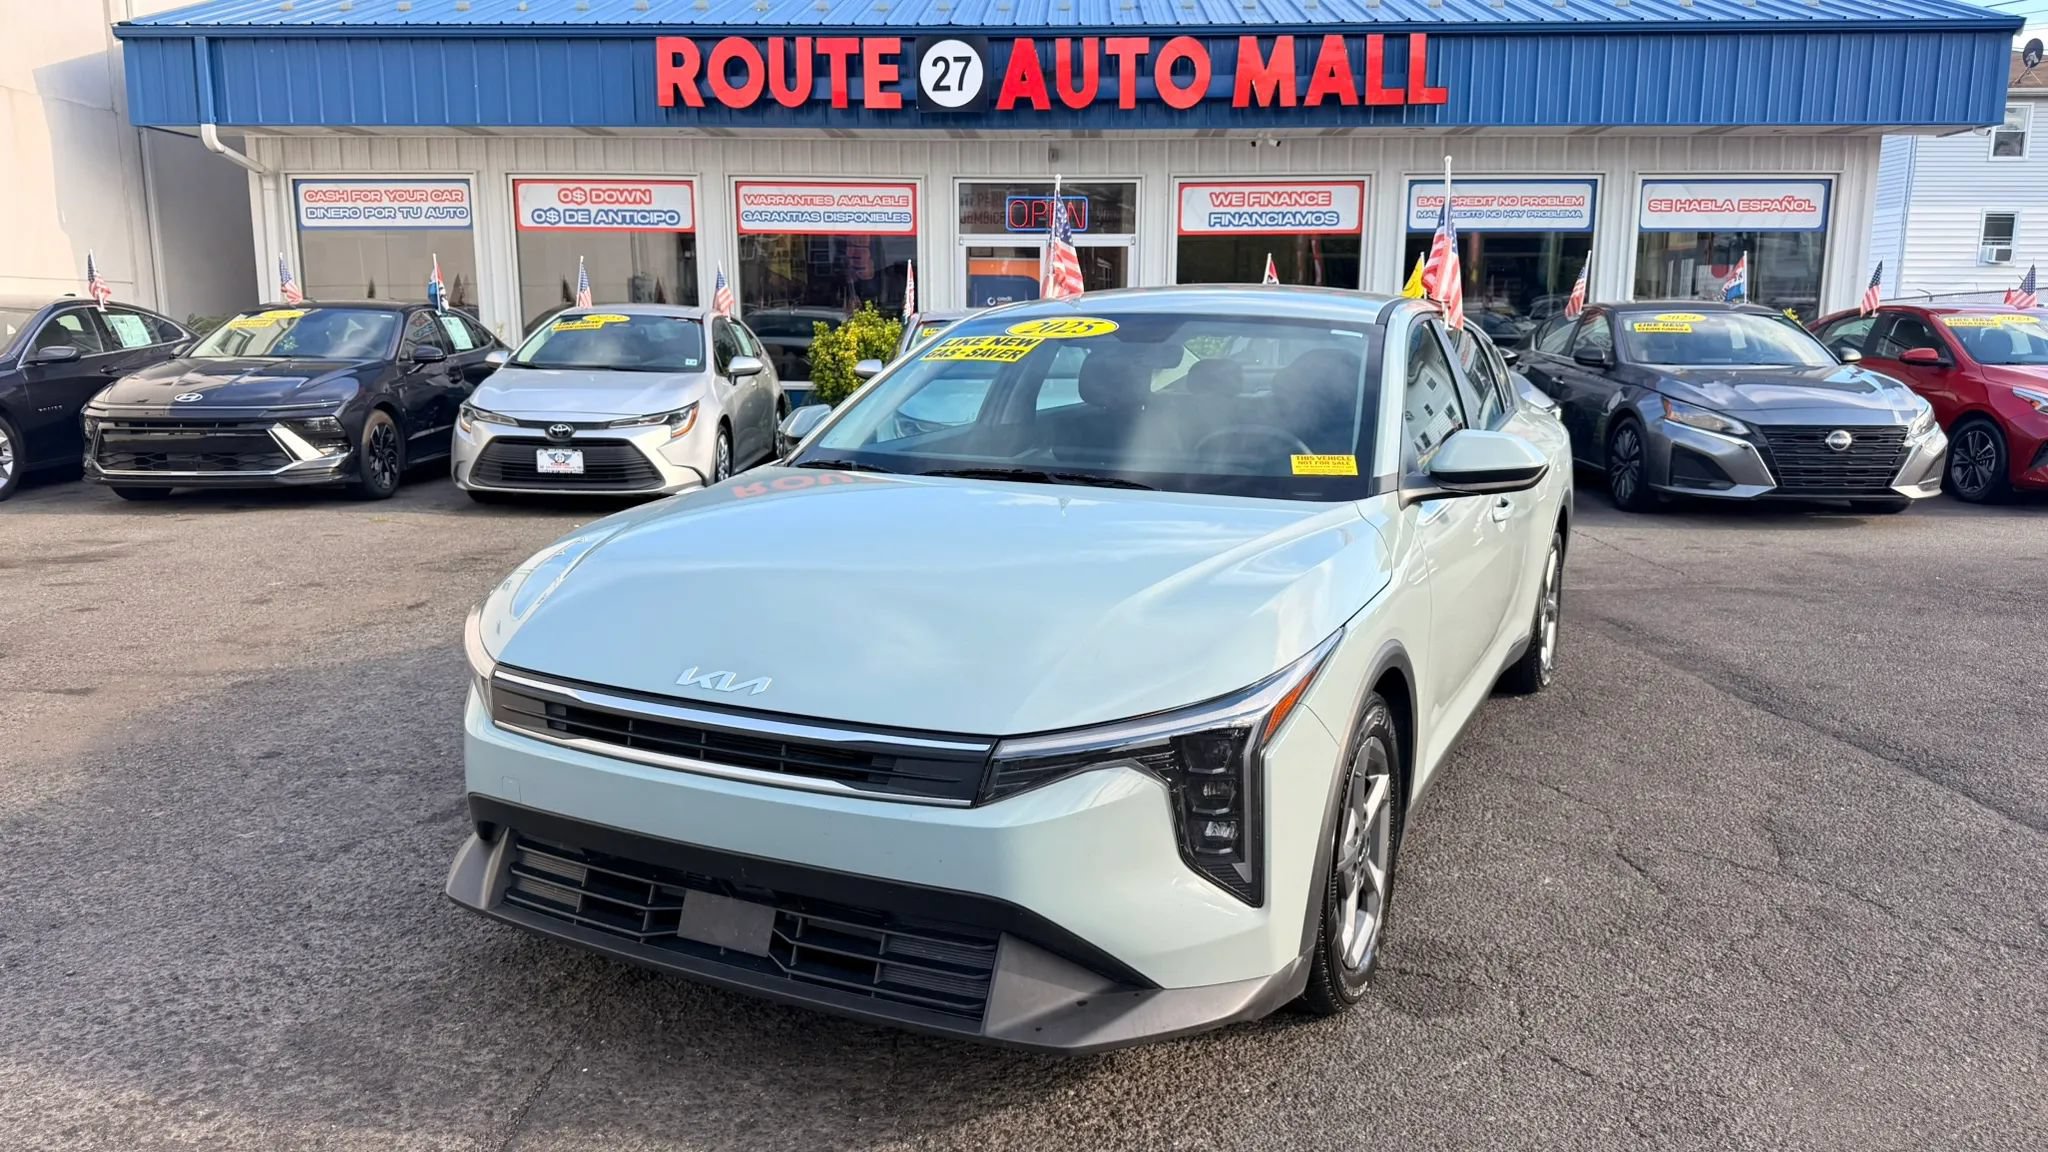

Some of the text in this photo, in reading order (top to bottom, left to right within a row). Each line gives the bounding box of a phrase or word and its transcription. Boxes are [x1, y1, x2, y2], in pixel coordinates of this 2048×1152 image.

[656, 33, 1448, 110] ROUTE 27 AUTO MALL
[304, 190, 464, 203] CASH FOR YOUR CAR
[590, 188, 652, 204] DOWN
[744, 194, 909, 207] WARRANTIES AVAILABLE
[1209, 191, 1331, 207] WE FINANCE
[1417, 195, 1584, 207] BAD CREDIT NO PROBLEM
[1648, 195, 1816, 213] SE HABLA ESPAÑOL
[306, 207, 469, 220] DINERO POR TU AUTO
[563, 209, 591, 224] DE
[593, 209, 680, 226] ANTICIPO
[742, 211, 912, 223] GARANTIAS DISPONIBLES
[1208, 211, 1339, 227] FINANCIAMOS
[1416, 210, 1583, 219] MAL REDITO NO HAY PROBLEMA
[1022, 321, 1104, 334] 2025
[940, 337, 1036, 347] LIKE NEW
